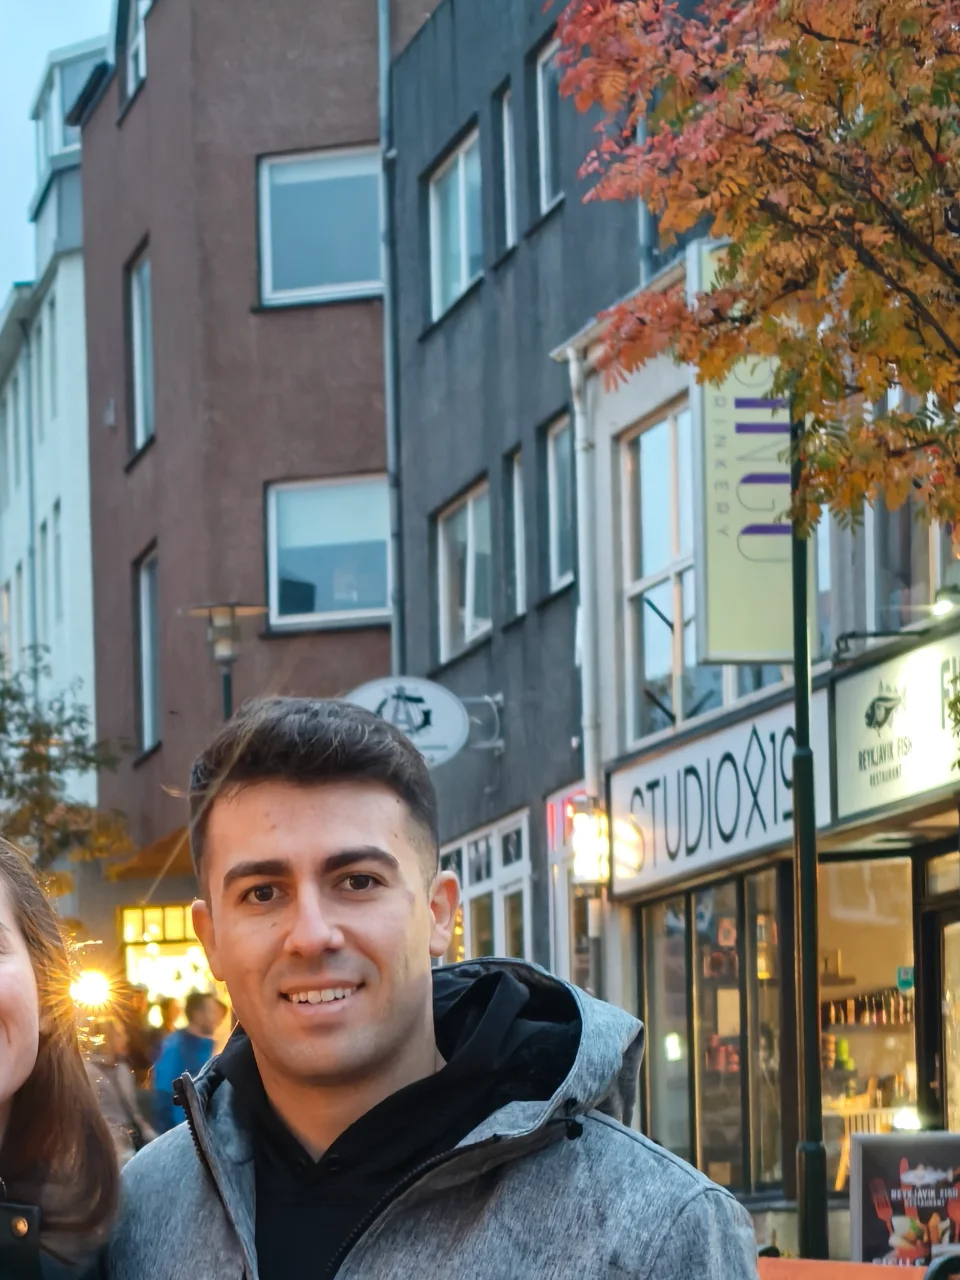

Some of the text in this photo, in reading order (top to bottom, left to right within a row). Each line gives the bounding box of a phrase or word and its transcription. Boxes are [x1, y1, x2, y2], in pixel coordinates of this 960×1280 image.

[713, 378, 730, 538] RINKERY
[630, 751, 741, 873] STUDIO
[858, 736, 912, 772] REYKJAVIK FISH
